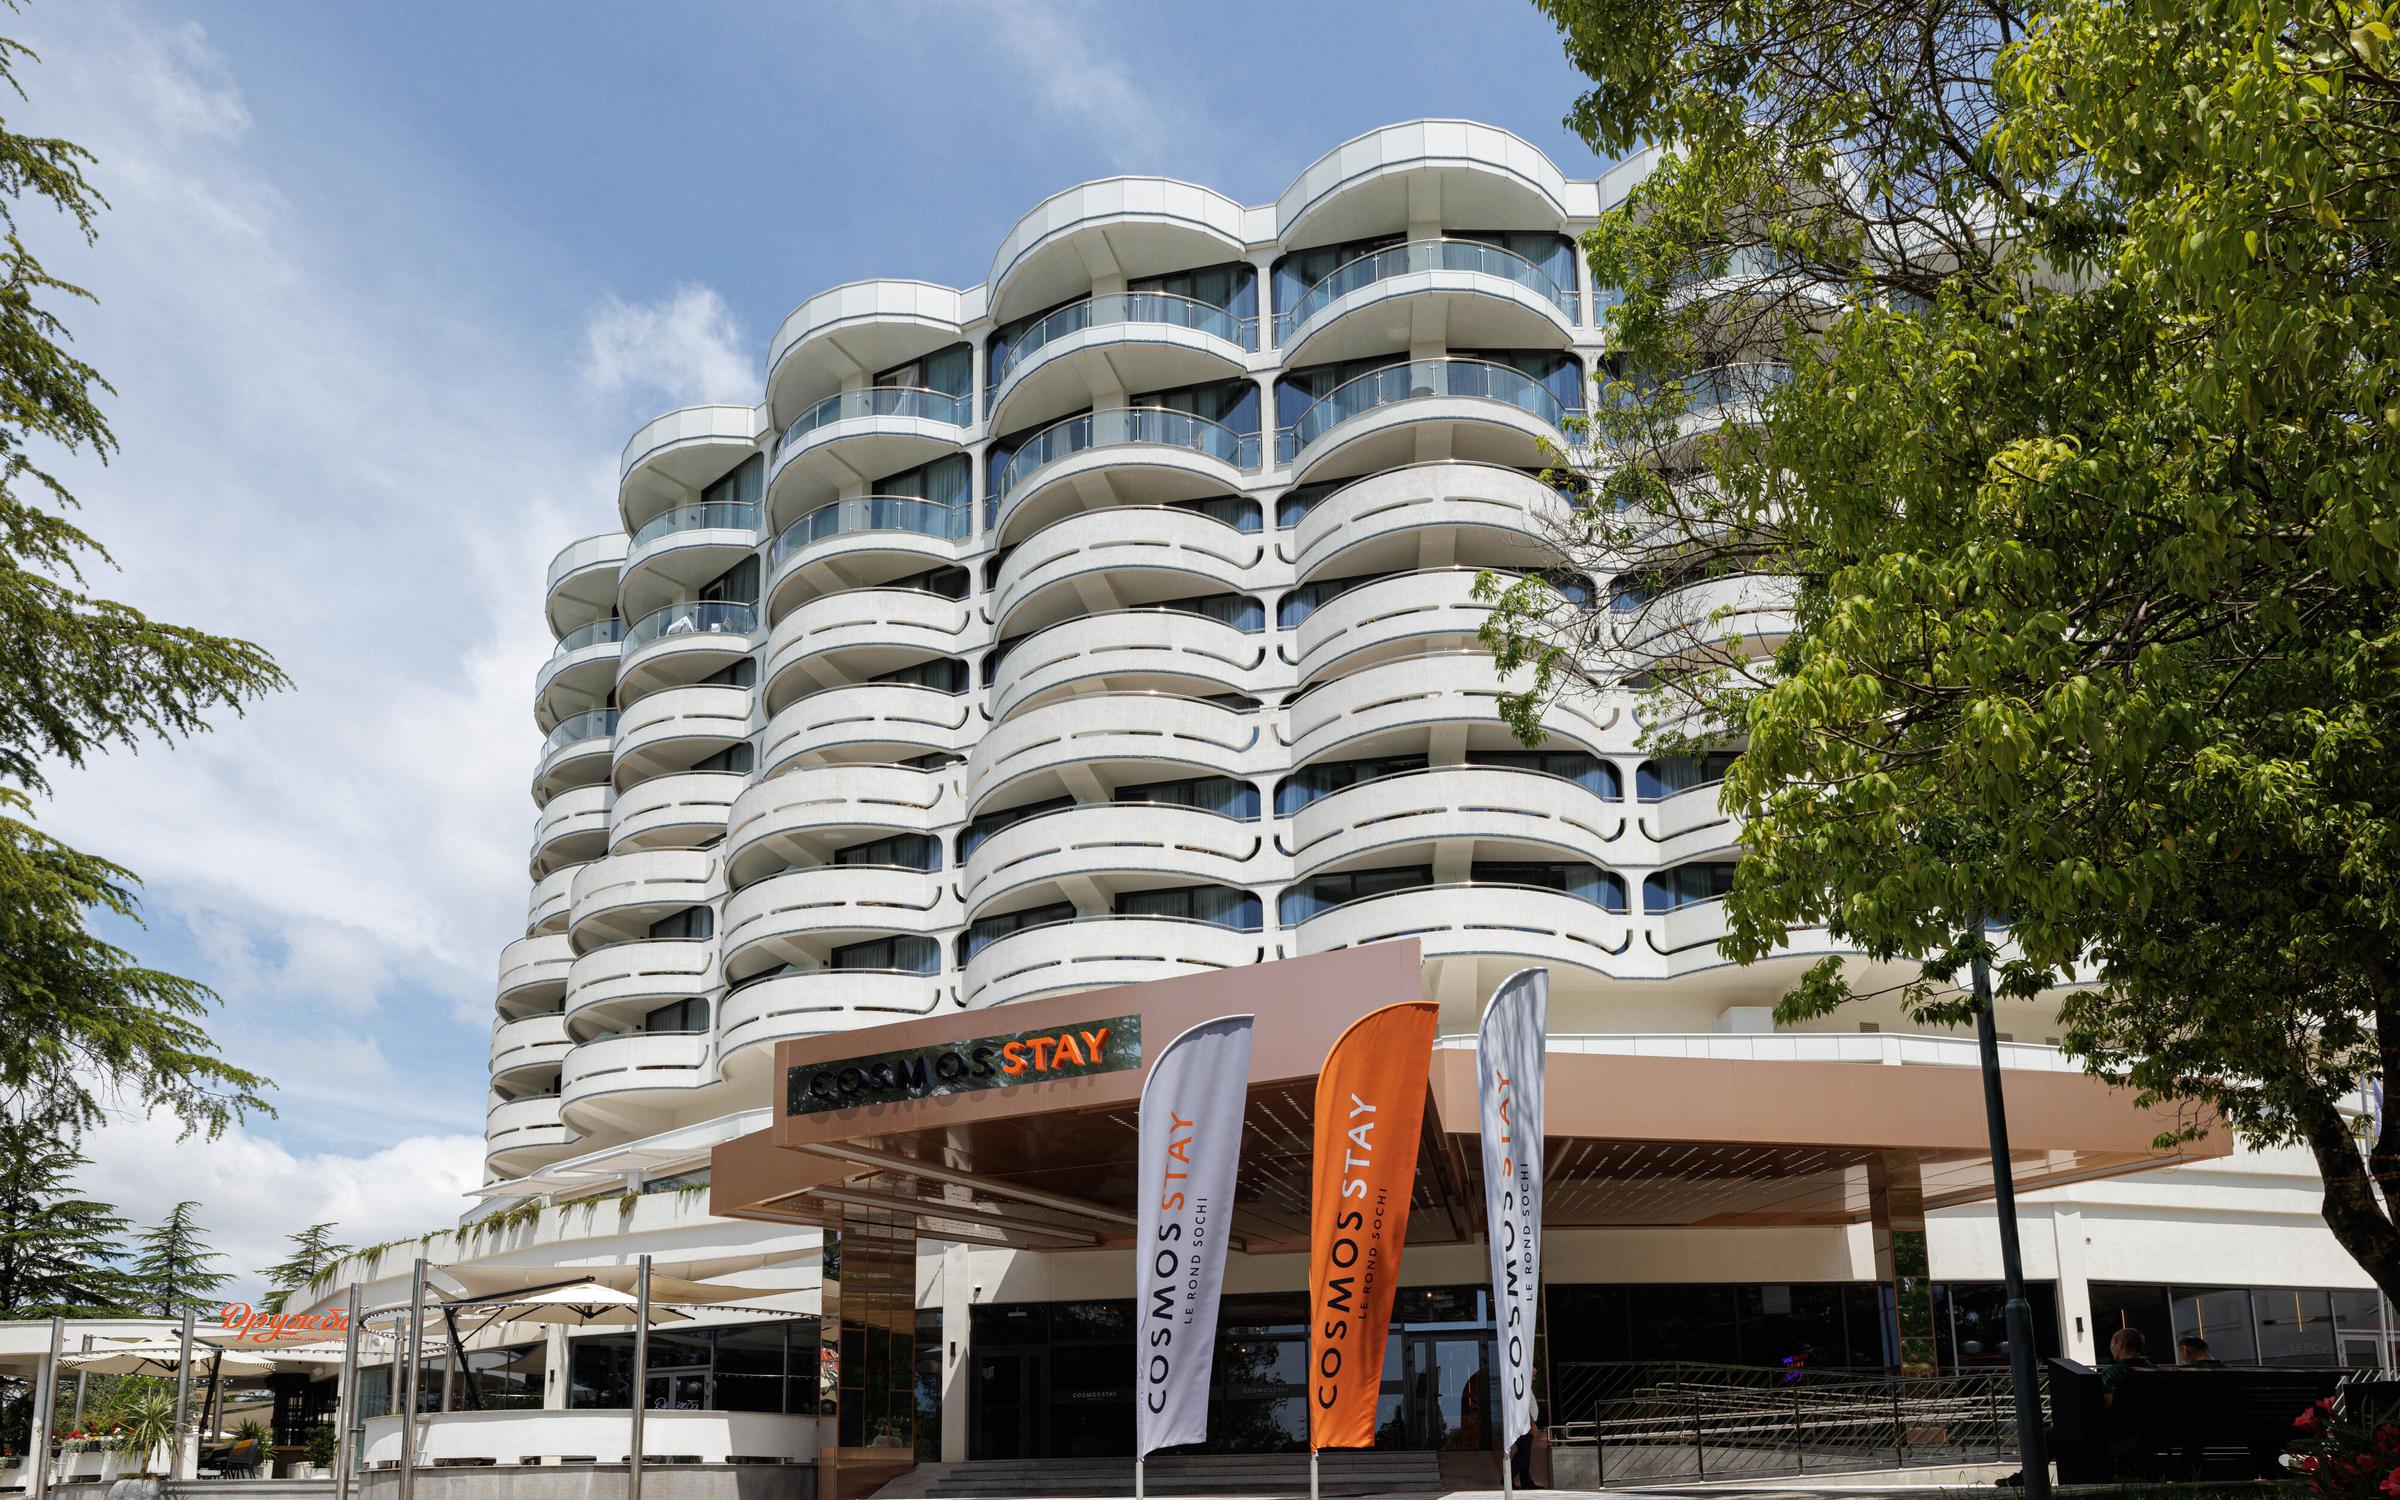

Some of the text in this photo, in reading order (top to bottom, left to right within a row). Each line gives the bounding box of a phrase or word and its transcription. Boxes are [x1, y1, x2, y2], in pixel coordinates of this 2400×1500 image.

[810, 1028, 1110, 1100] COSMOS STAY
[1148, 1111, 1193, 1414] COSMOS STAY
[1184, 1198, 1208, 1325] LE ROND SOCHI
[1318, 1093, 1376, 1409] COSMOS STAY
[1358, 1188, 1387, 1320] LE ROND SOCHI
[1520, 1164, 1532, 1301] LE ROND SOCHI
[300, 1335, 349, 1344] NOVIKO
